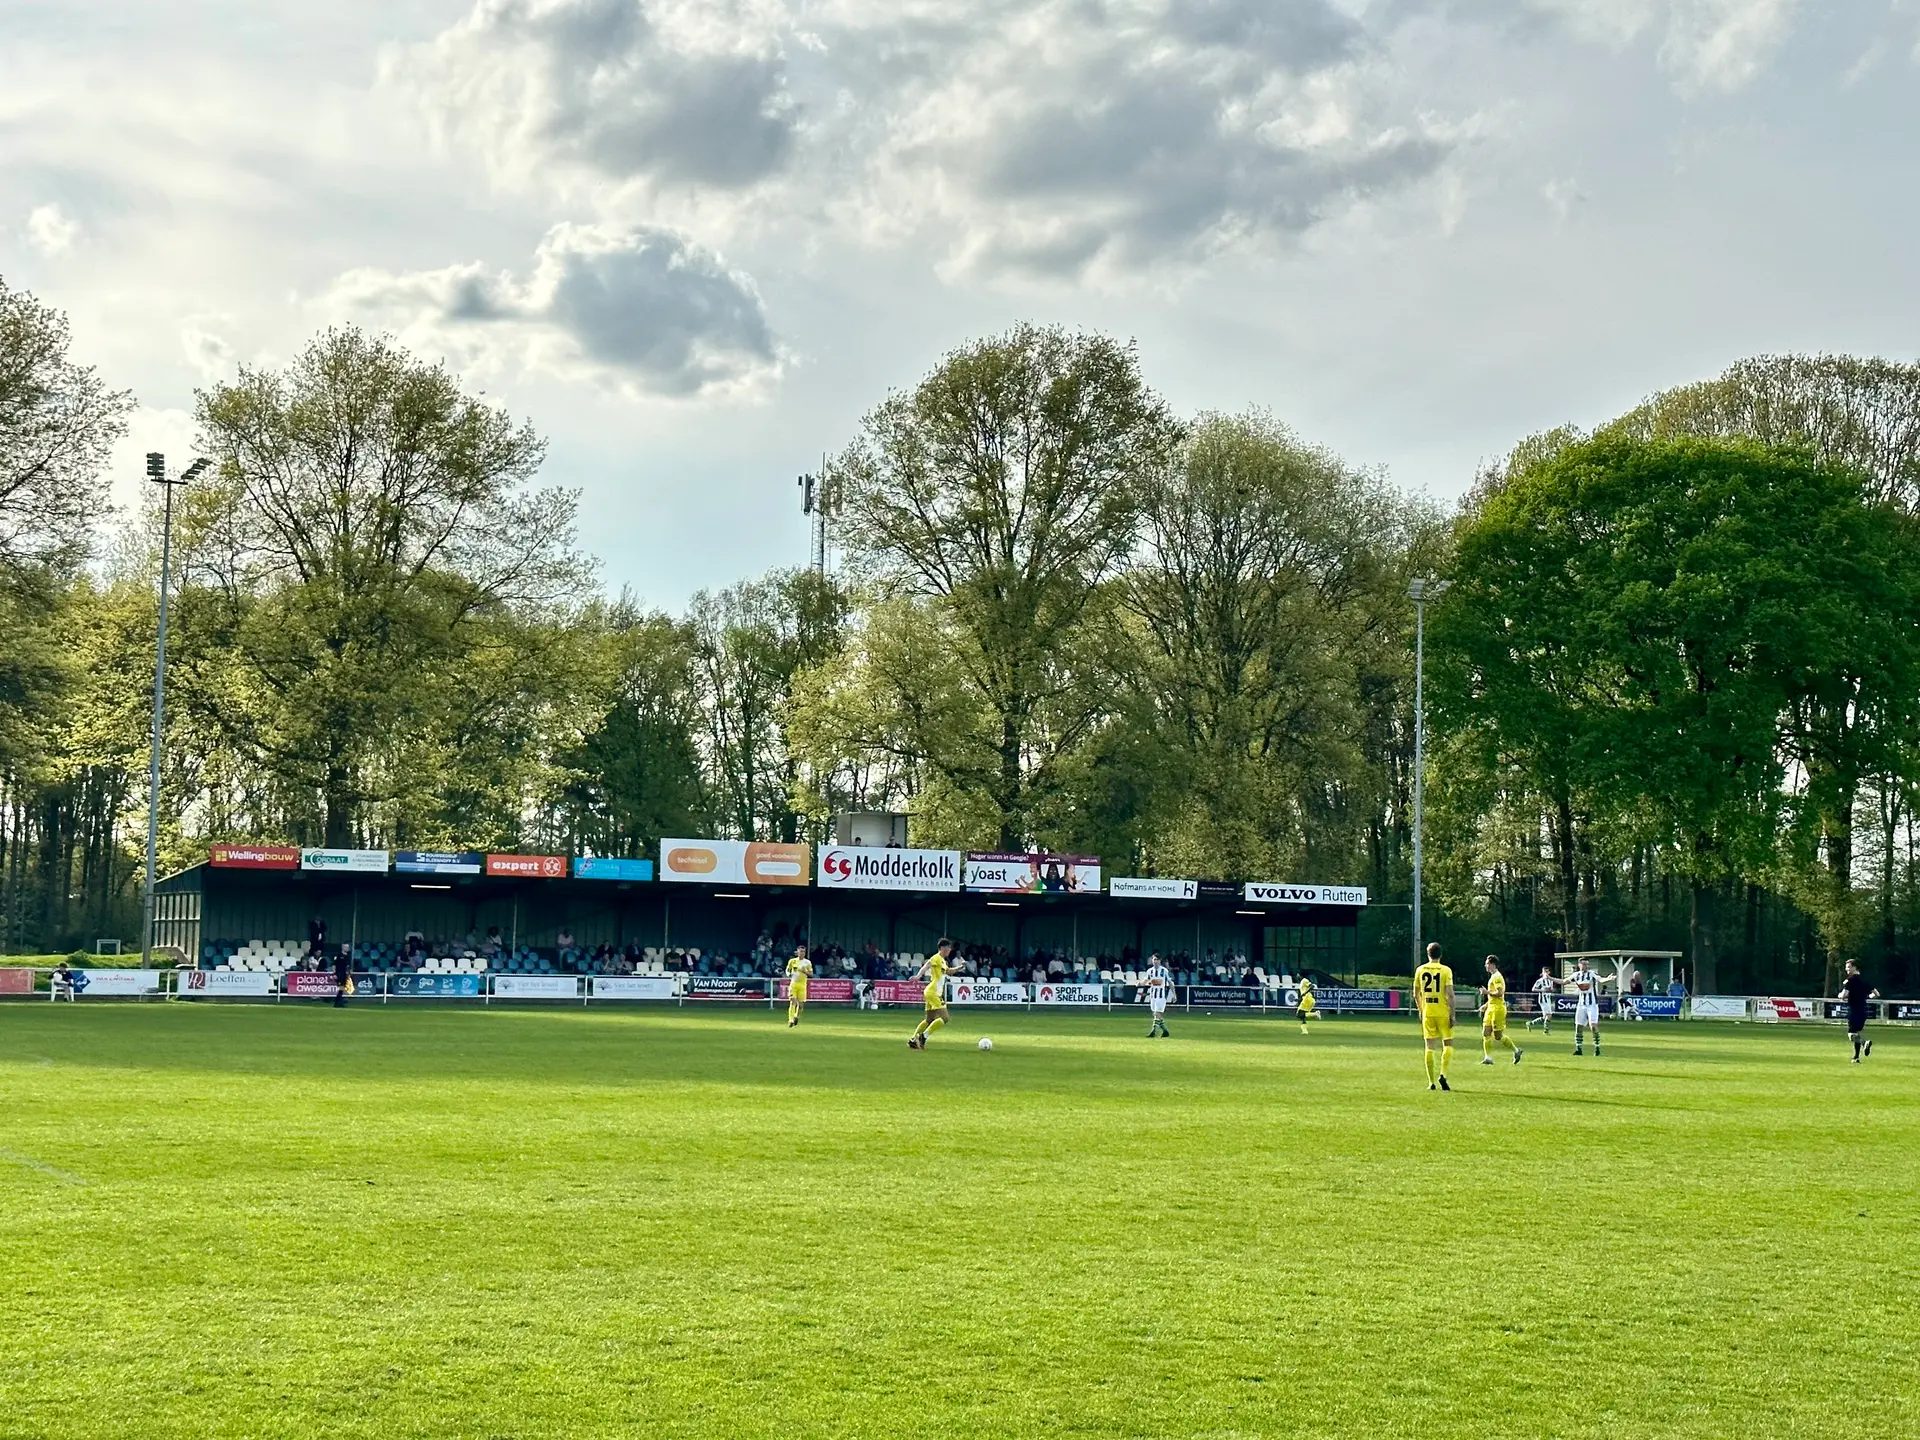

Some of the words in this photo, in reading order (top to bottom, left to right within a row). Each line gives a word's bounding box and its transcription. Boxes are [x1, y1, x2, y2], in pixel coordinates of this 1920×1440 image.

[228, 850, 294, 862] Wellingbouw
[492, 861, 539, 871] expert
[855, 854, 954, 879] Modderkolk
[970, 866, 1007, 884] yoast
[1114, 882, 1147, 892] Hofmans
[1251, 888, 1316, 900] VOLVO
[1322, 888, 1362, 902] Rutten
[296, 976, 328, 984] planet
[694, 978, 710, 987] VAN
[710, 979, 738, 988] NOORT
[1422, 972, 1440, 992] 21
[296, 984, 338, 993] awesom
[975, 993, 1018, 1001] SNELDERS
[1057, 994, 1098, 1002] SNELDERS
[1194, 990, 1220, 998] Verhuur
[1220, 990, 1246, 1000] Wijchen
[1327, 990, 1334, 998] &
[1334, 991, 1384, 999] KAMPSCHREUR
